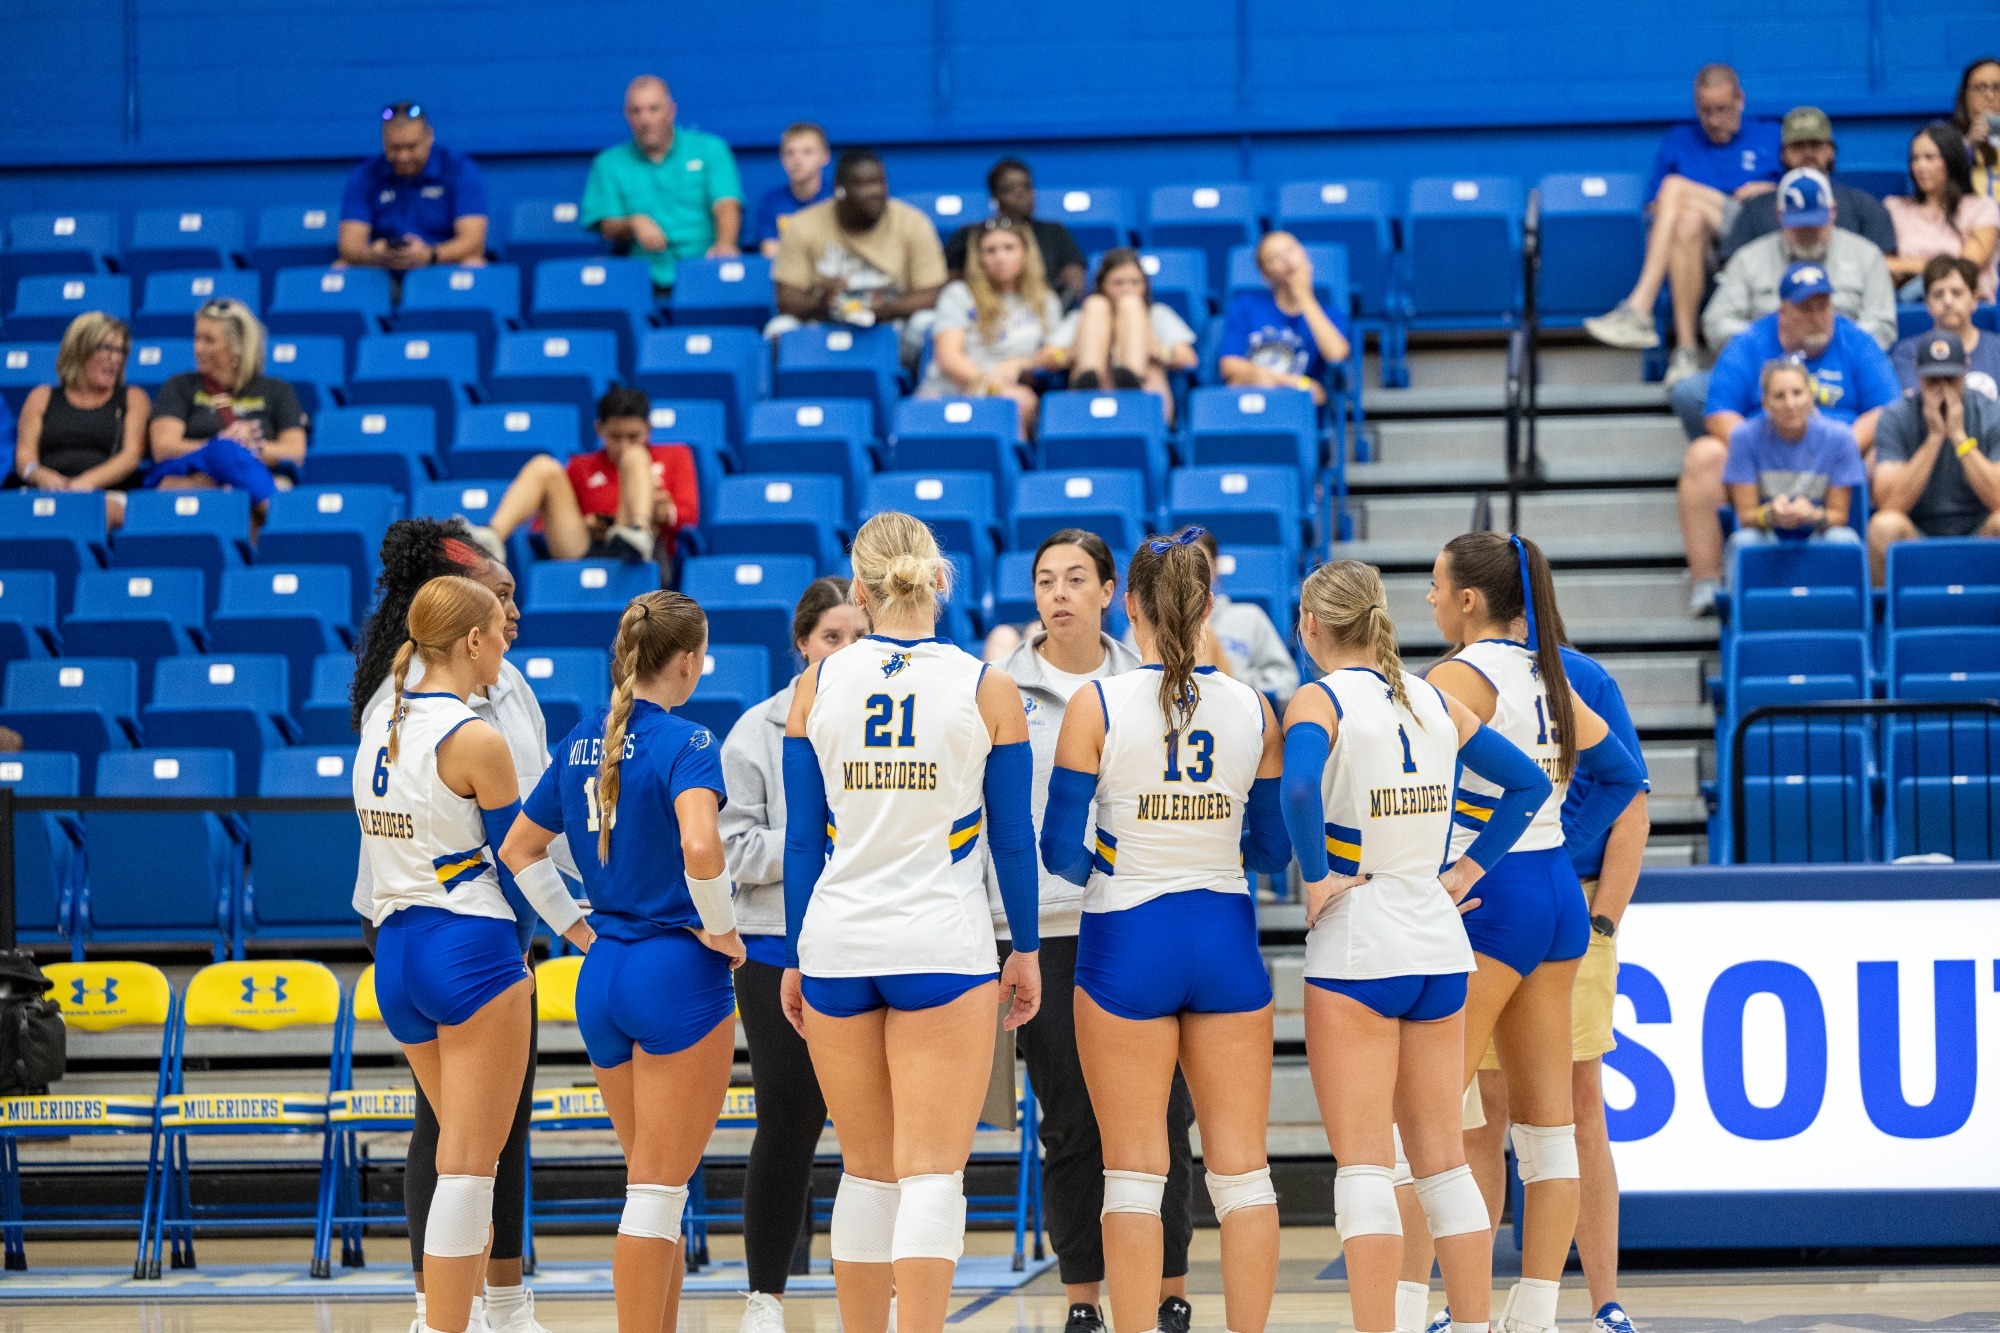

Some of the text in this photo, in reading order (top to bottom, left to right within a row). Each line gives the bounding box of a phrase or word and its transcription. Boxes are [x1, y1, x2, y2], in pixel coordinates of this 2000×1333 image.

[864, 693, 917, 749] 21
[1162, 729, 1216, 783] 13
[1398, 723, 1418, 775] 1
[371, 746, 390, 798] 6
[843, 760, 938, 790] MULERIDERS
[583, 776, 617, 832] 1
[1136, 793, 1231, 821] MULERIDERS
[1370, 784, 1448, 818] MULERIDERS
[358, 807, 415, 840] MULERIDERS
[1601, 959, 2000, 1143] SOU
[7, 1099, 102, 1122] MULERIDERS
[183, 1097, 279, 1120] MULERIDERS
[351, 1094, 416, 1114] MULERID
